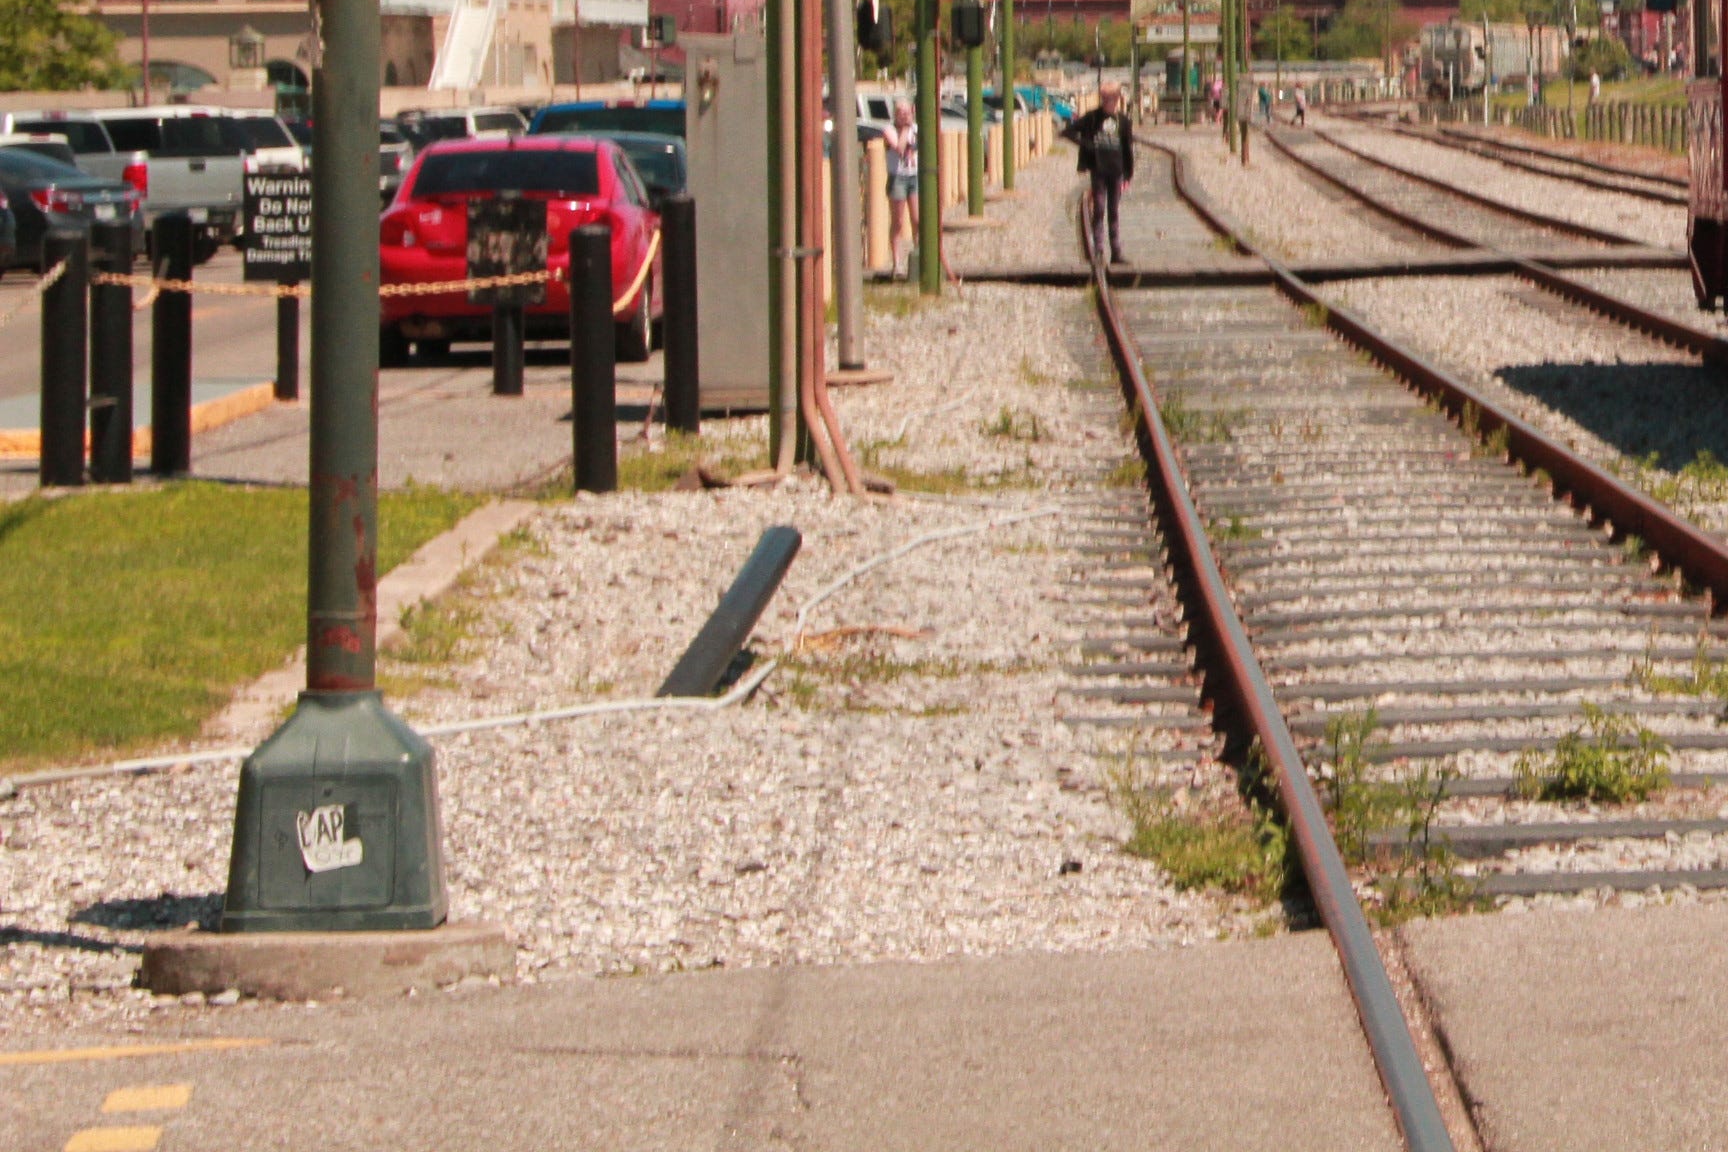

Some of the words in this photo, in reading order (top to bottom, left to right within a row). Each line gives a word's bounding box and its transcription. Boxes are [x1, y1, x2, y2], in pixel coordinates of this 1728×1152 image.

[248, 176, 312, 196] Warnin
[259, 197, 283, 215] Do
[253, 215, 294, 234] Back
[297, 215, 311, 233] U
